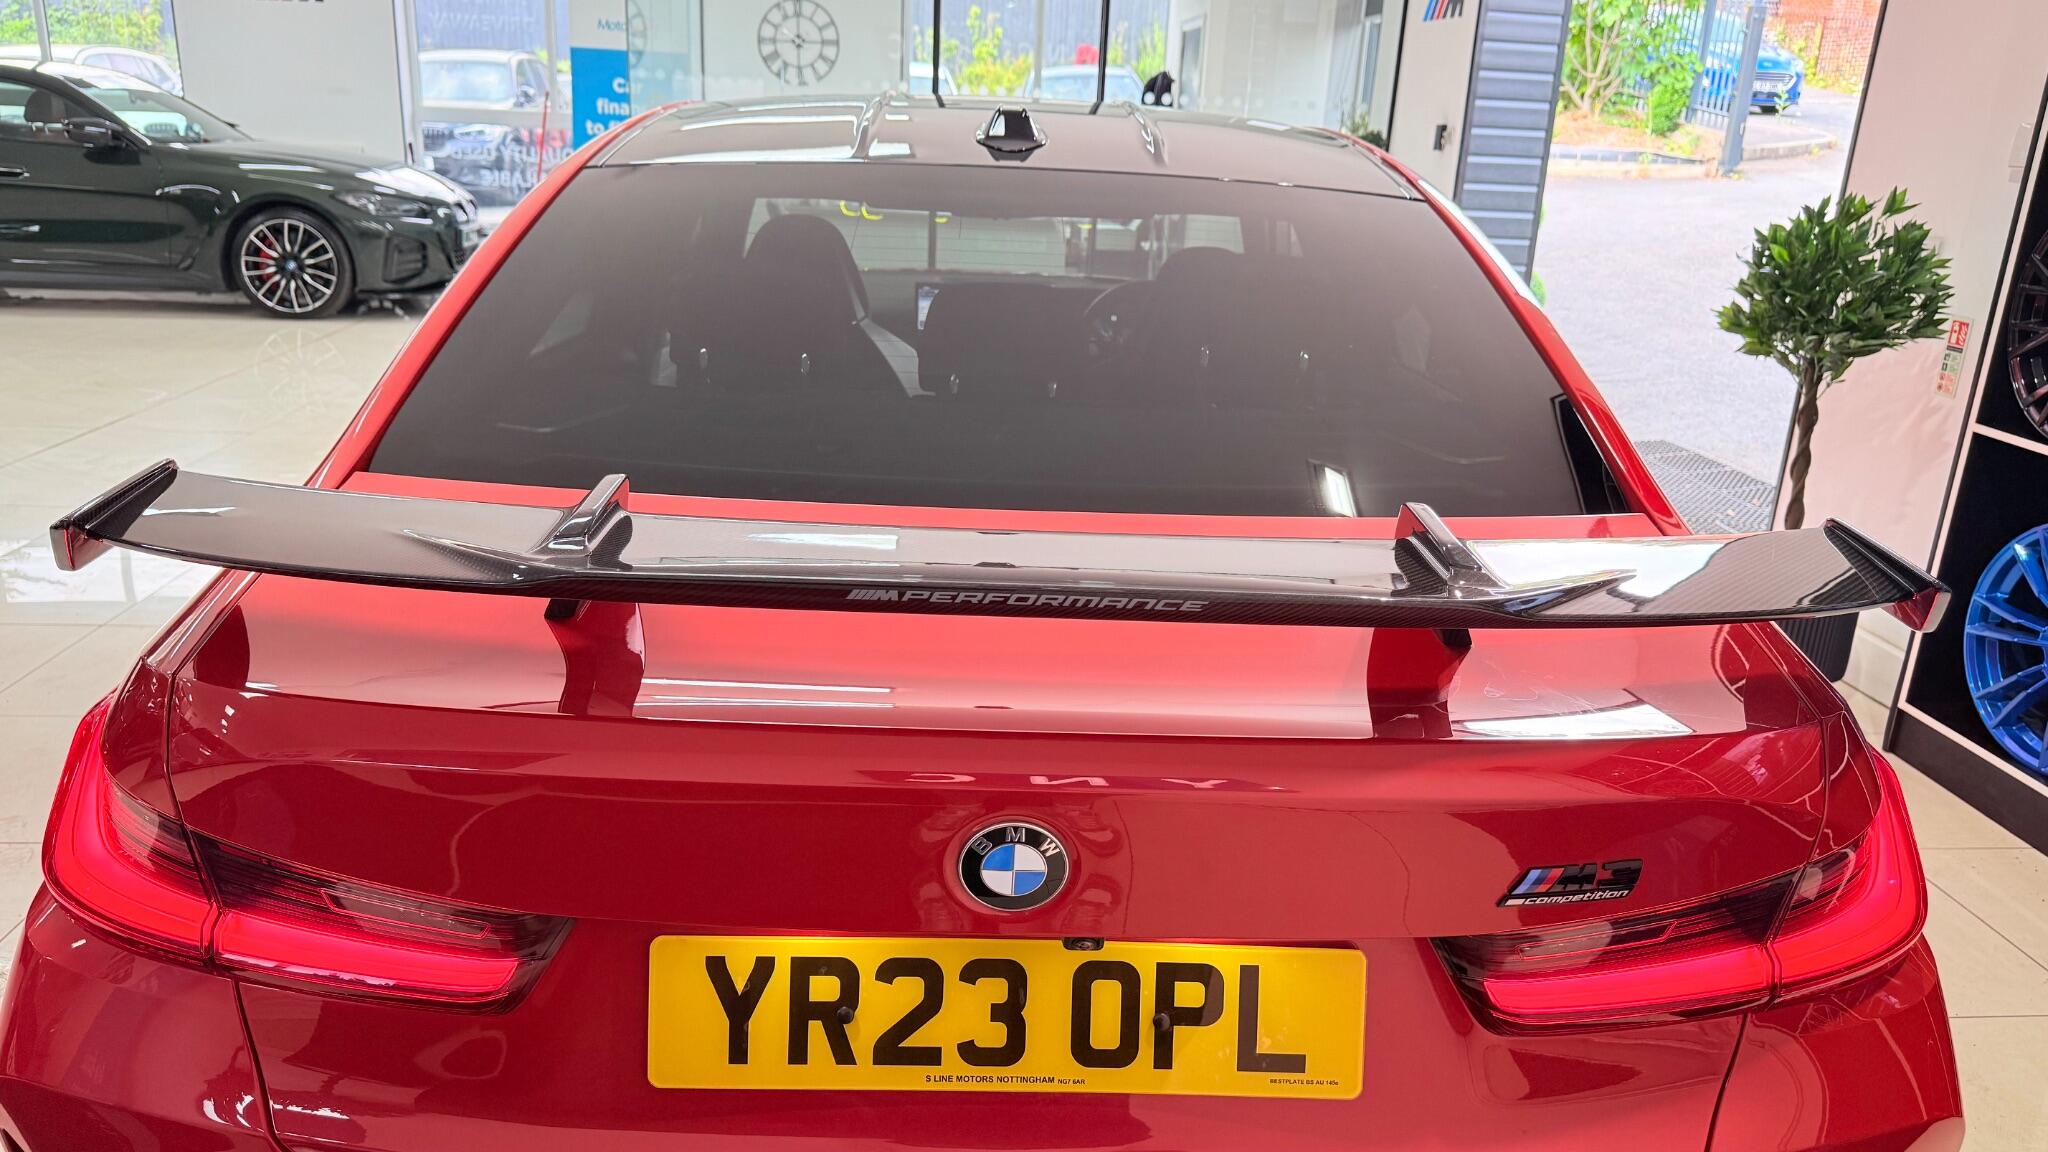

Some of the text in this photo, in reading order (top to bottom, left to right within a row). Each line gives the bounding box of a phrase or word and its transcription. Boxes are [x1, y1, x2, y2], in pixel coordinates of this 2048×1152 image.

[901, 590, 1210, 612] PERFORMANCE
[971, 826, 1061, 858] BMW
[1523, 889, 1630, 905] competition
[705, 955, 1307, 1073] YR23 OPL
[933, 1075, 954, 1083] LINE
[955, 1075, 994, 1083] MOTORS
[996, 1076, 1055, 1084] NOTTINGHAM
